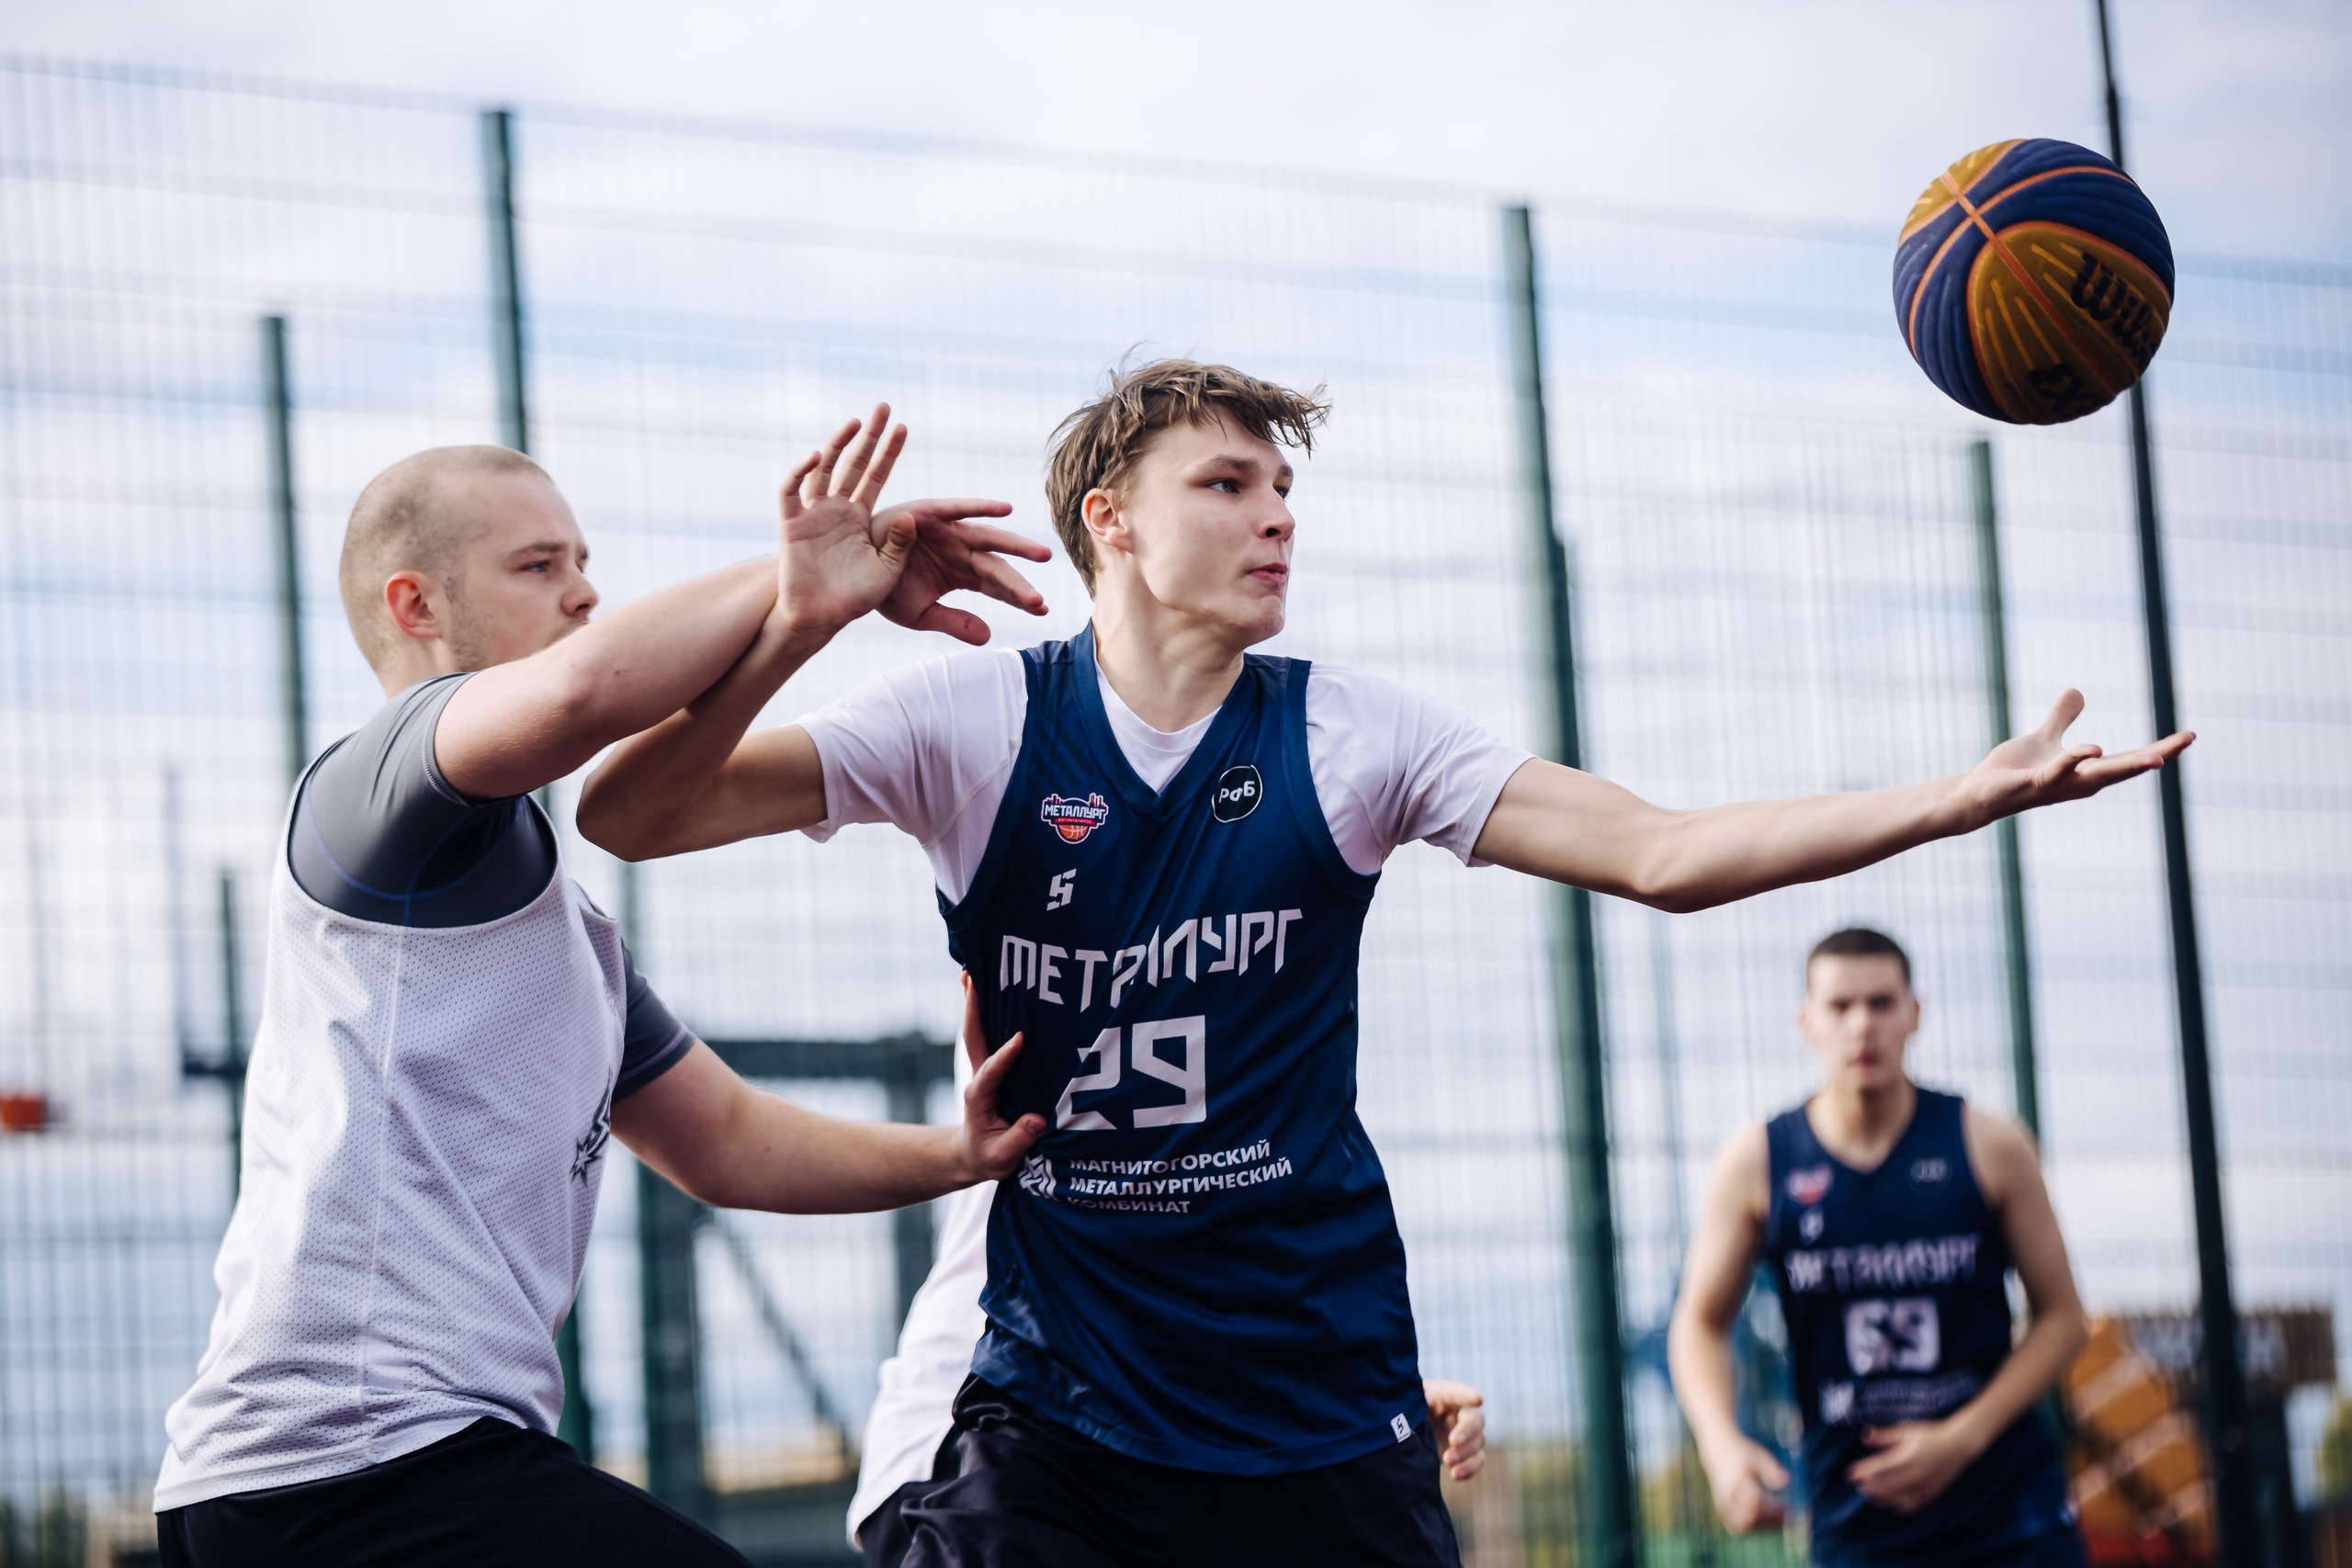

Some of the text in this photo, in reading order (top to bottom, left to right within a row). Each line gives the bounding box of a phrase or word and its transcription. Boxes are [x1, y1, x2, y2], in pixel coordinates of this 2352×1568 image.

[1044, 804, 1106, 819] МЕТАЛЛУРГ
[1056, 1015, 1207, 1131] 29
[1069, 1156, 1293, 1195] МЕТАЛЛУРГИЧЕСКИЙ
[1070, 1139, 1271, 1176] МАГНИТОГОРСКИЙ
[1843, 1297, 1941, 1376] 69
